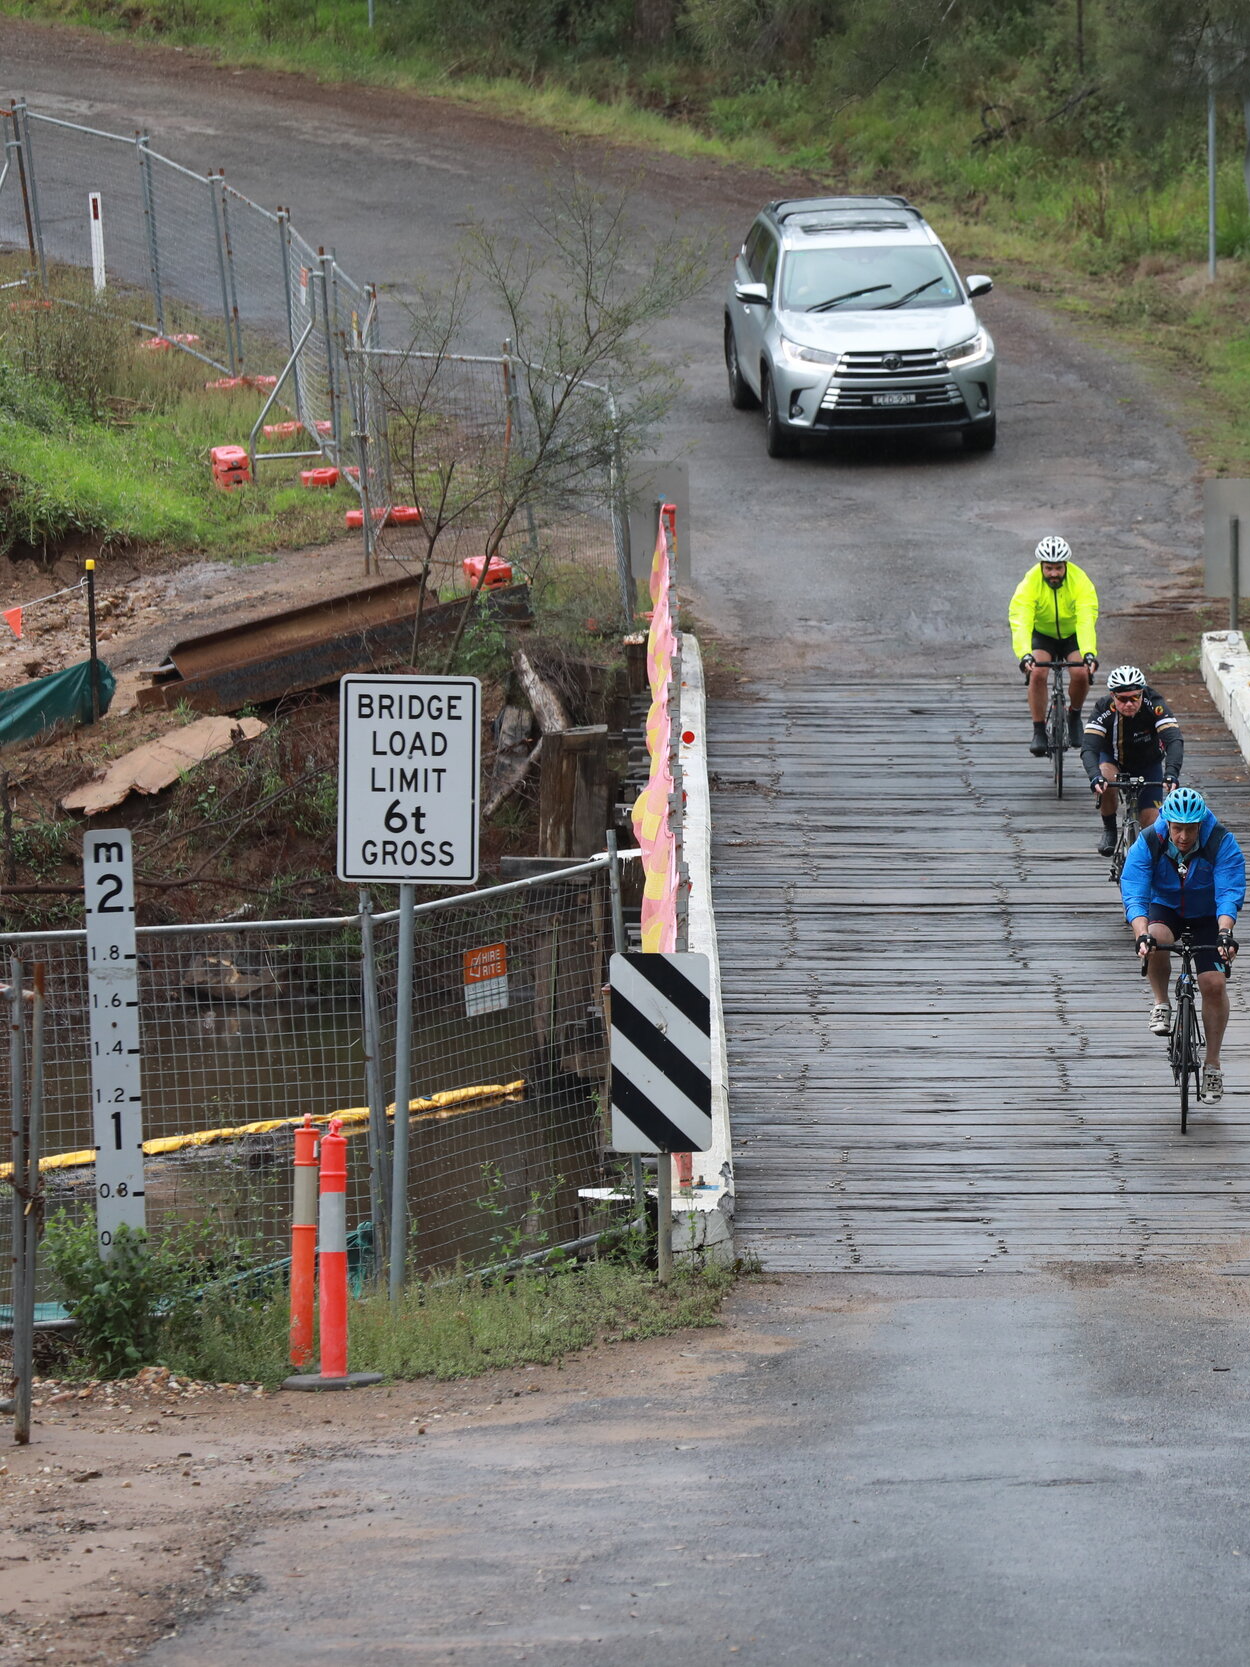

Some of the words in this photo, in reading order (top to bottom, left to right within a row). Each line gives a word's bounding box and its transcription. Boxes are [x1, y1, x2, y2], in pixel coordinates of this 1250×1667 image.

[357, 693, 462, 720] BRIDGE
[372, 730, 448, 757] LOAD
[371, 767, 447, 793] LIMIT
[384, 798, 426, 834] 6t
[93, 840, 124, 864] m
[361, 839, 455, 866] GROSS
[97, 874, 125, 913] 2
[90, 945, 120, 962] 1.8
[481, 949, 501, 963] HIRE
[482, 962, 502, 976] RITE
[93, 991, 122, 1008] 1.6
[94, 1040, 124, 1057] 1.4
[96, 1087, 126, 1104] 1.2
[110, 1111, 122, 1150] 1
[99, 1182, 128, 1198] 0.8
